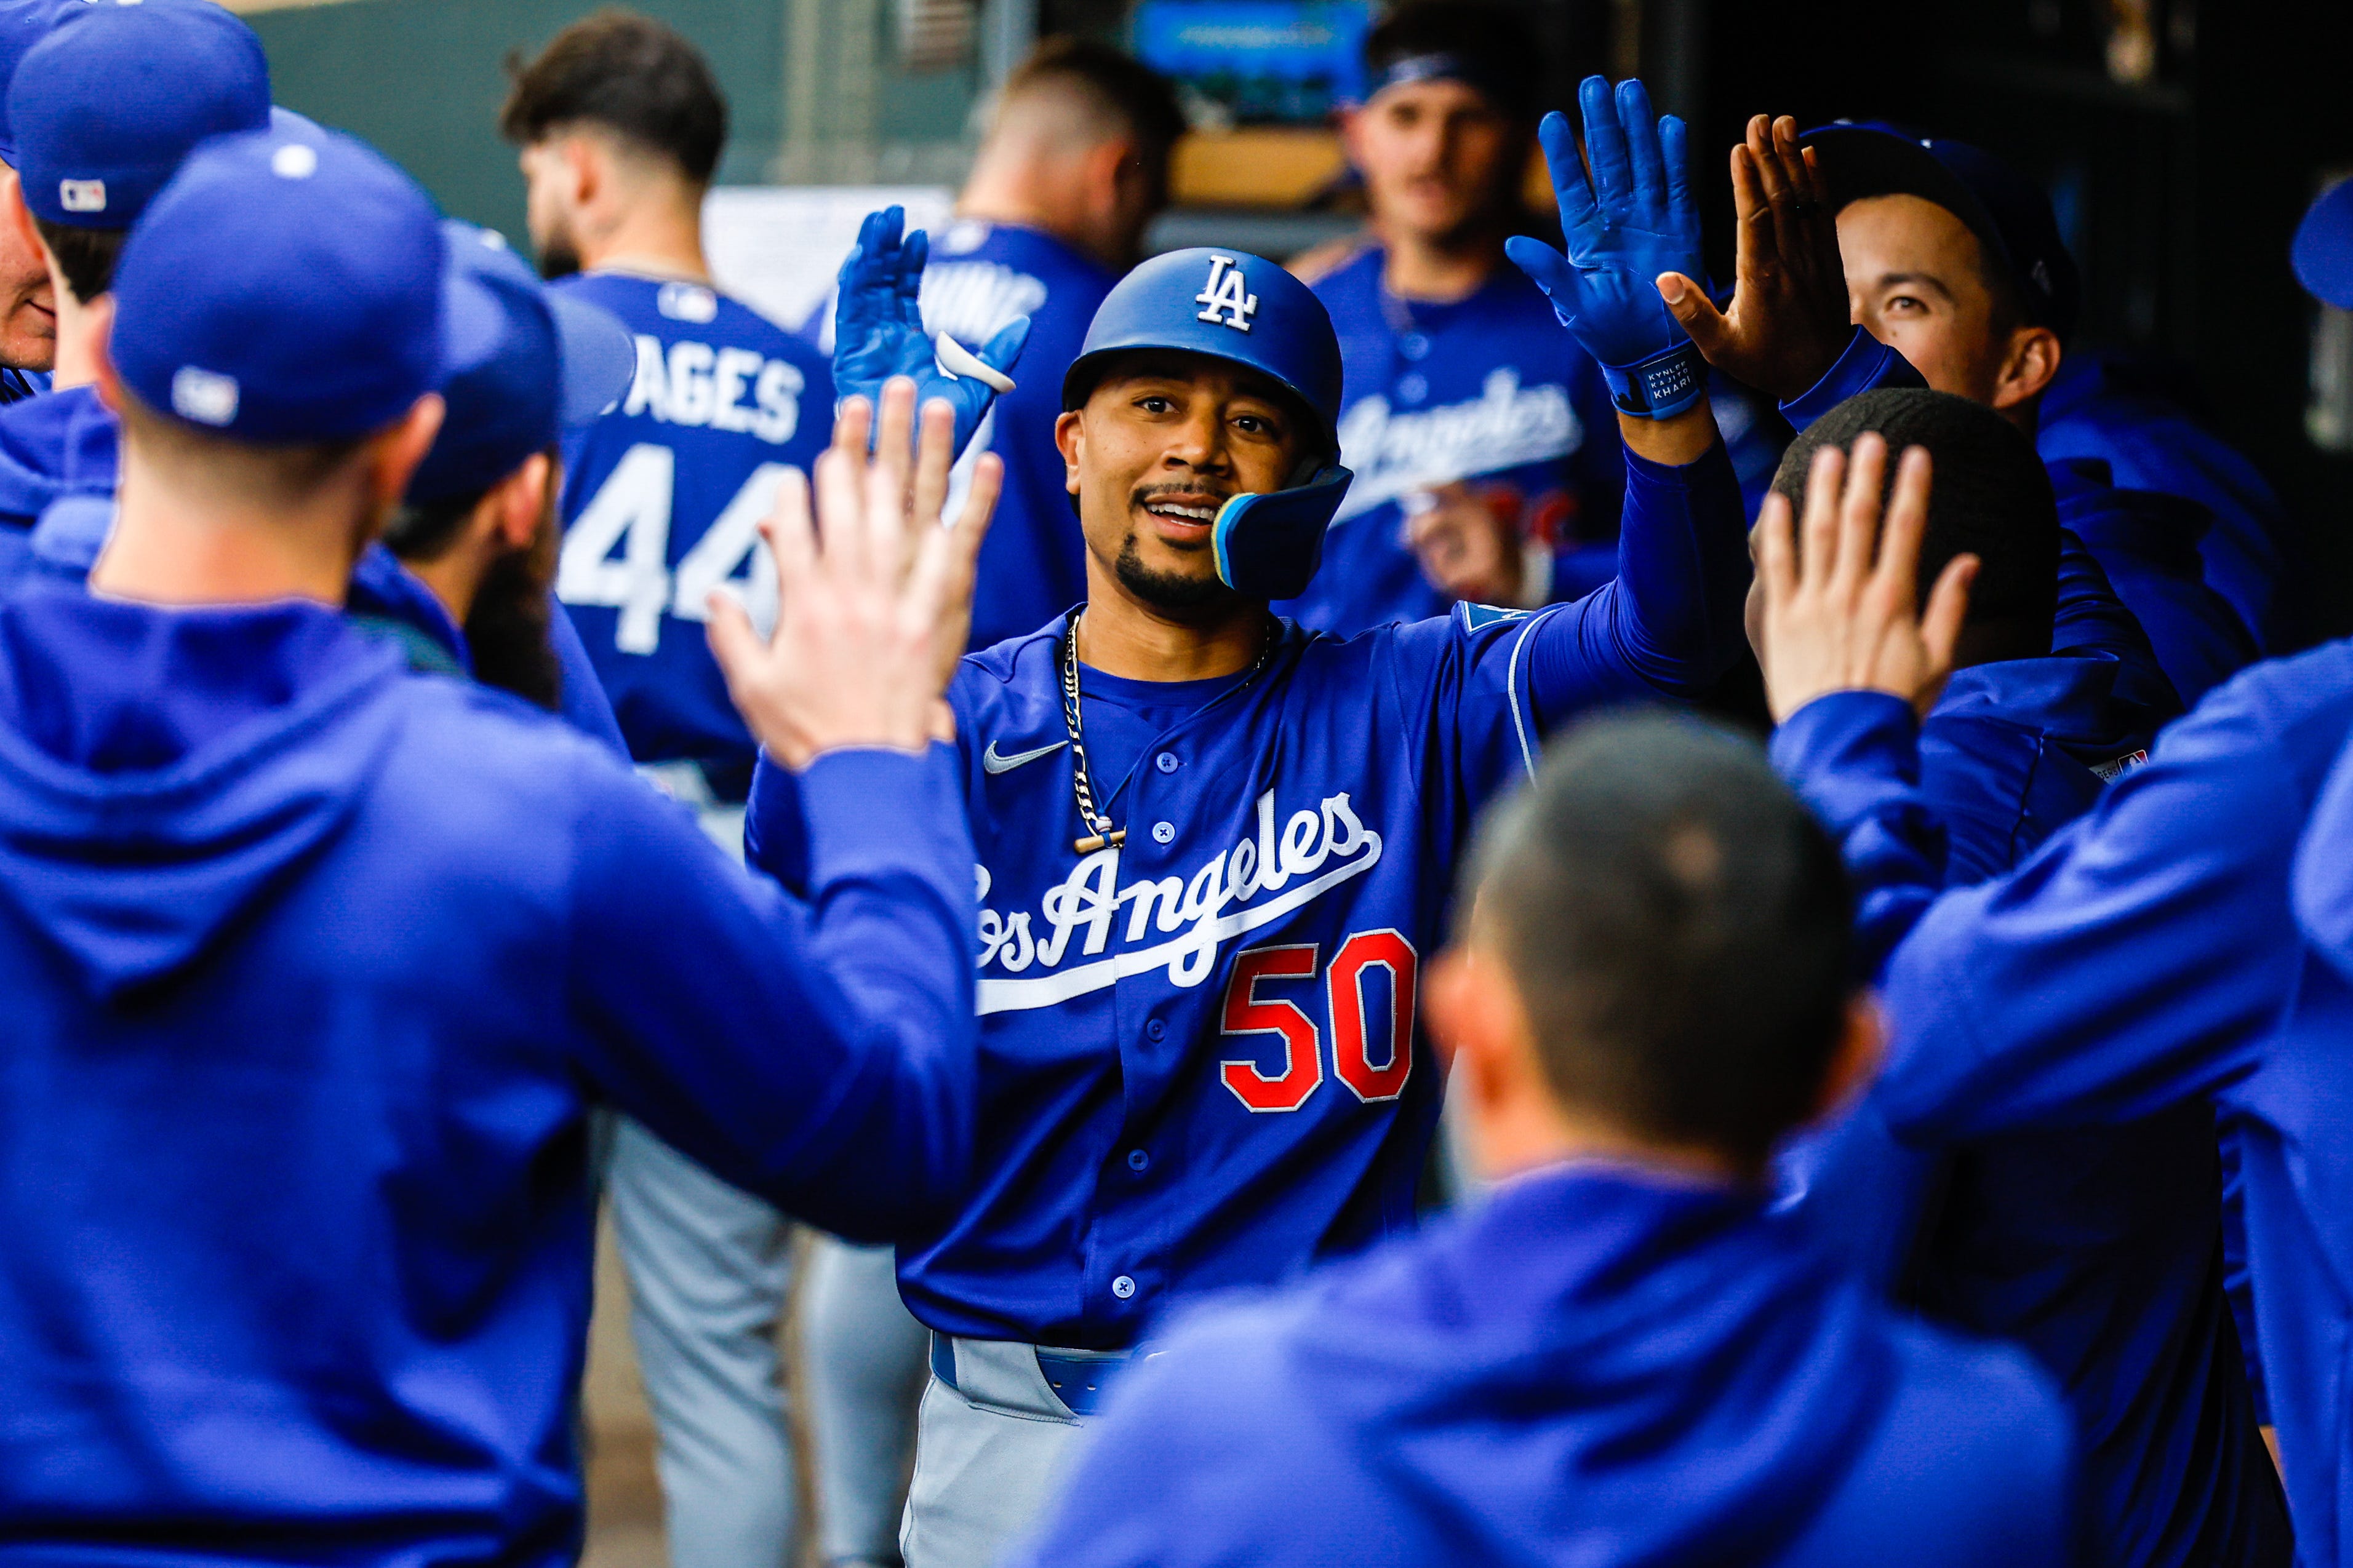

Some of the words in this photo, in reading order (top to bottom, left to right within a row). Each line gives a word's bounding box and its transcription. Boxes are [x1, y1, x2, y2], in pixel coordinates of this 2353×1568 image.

[1196, 255, 1257, 332] LA
[620, 333, 805, 445] AGES
[1653, 375, 1691, 399] KHARI
[556, 442, 809, 656] 44
[975, 862, 1035, 973] os
[1037, 789, 1367, 989] Angeles
[1220, 928, 1418, 1113] 50
